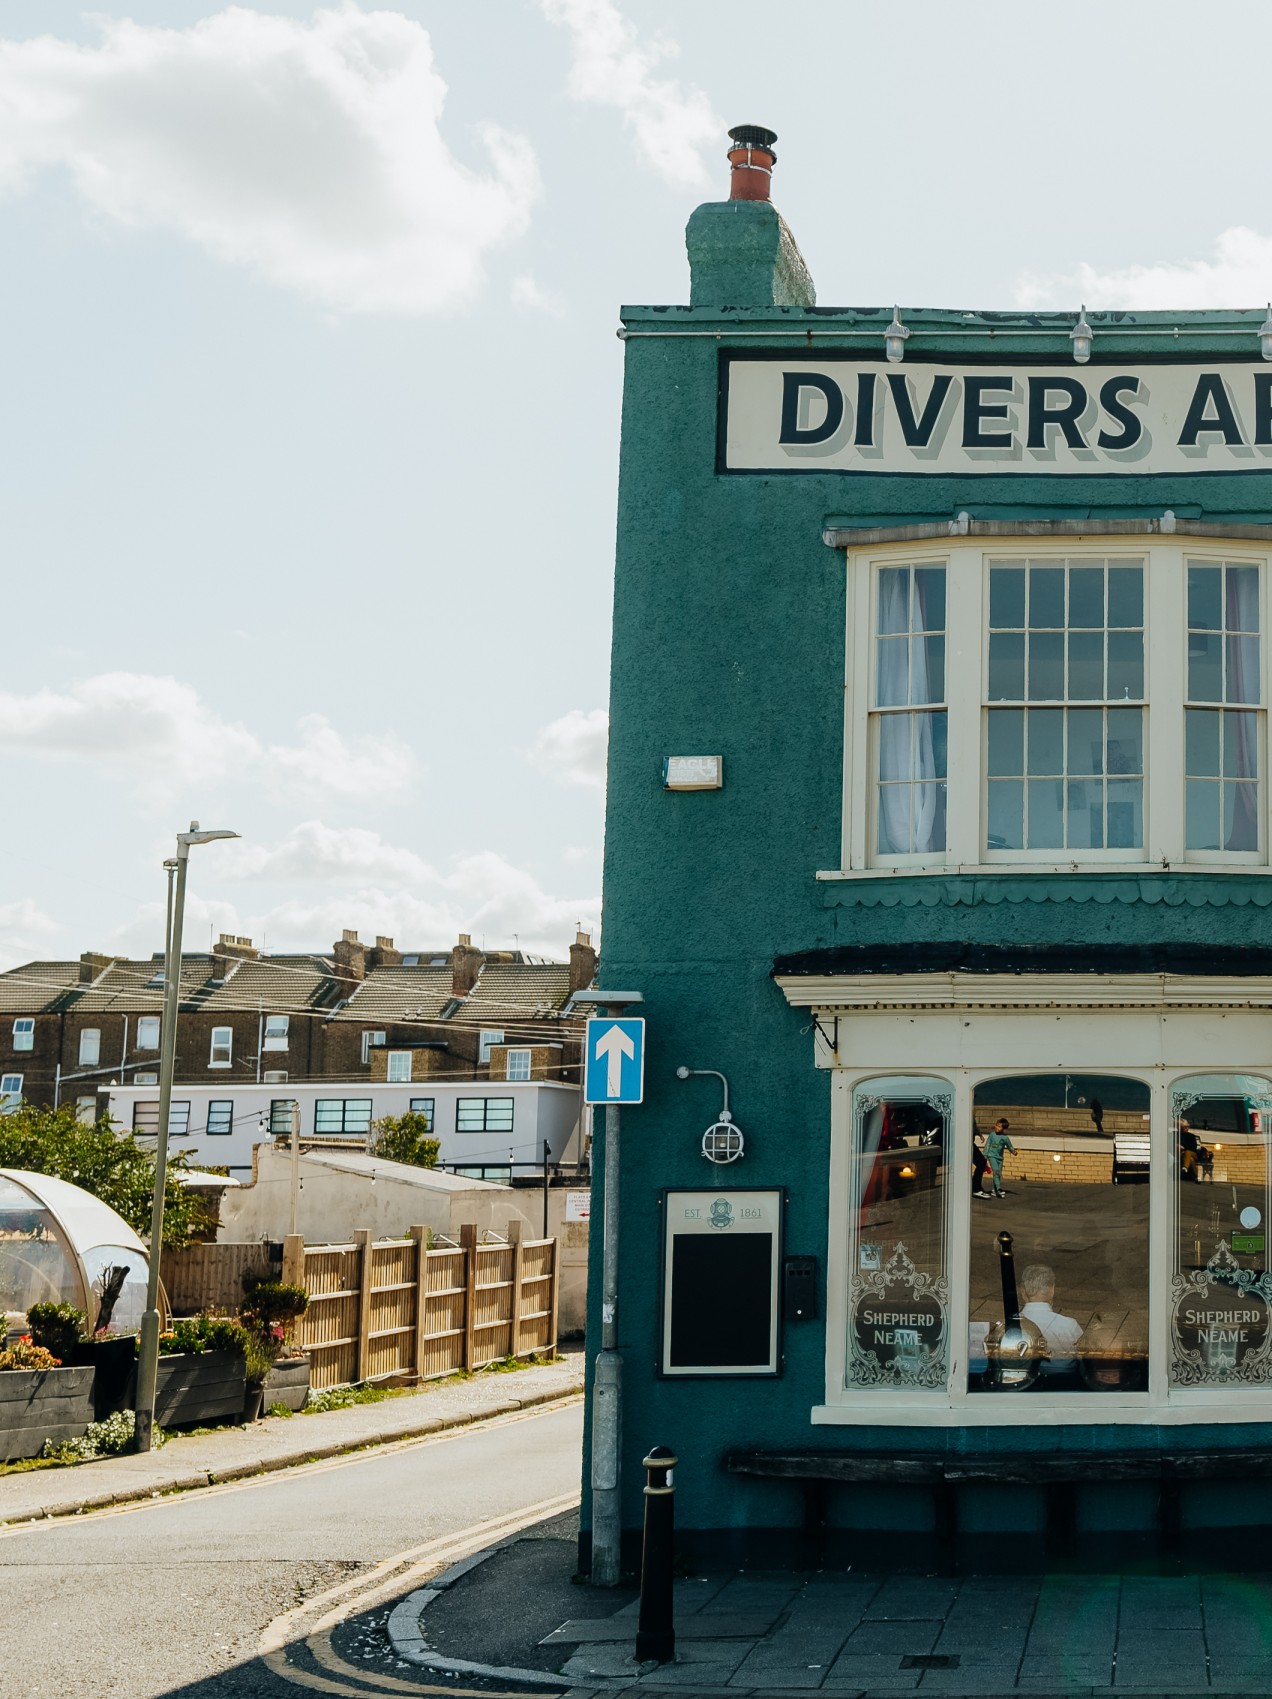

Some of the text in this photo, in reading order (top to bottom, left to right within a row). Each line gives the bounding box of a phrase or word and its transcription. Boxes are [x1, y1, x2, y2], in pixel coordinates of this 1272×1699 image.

[780, 371, 1142, 451] DIVERS
[670, 759, 716, 769] EAGLE
[740, 1208, 762, 1217] 1861
[863, 1310, 935, 1327] SHEPHERD
[1185, 1309, 1261, 1324] SHEPHERD
[874, 1330, 923, 1346] NEAME
[1197, 1329, 1249, 1343] NEAME
